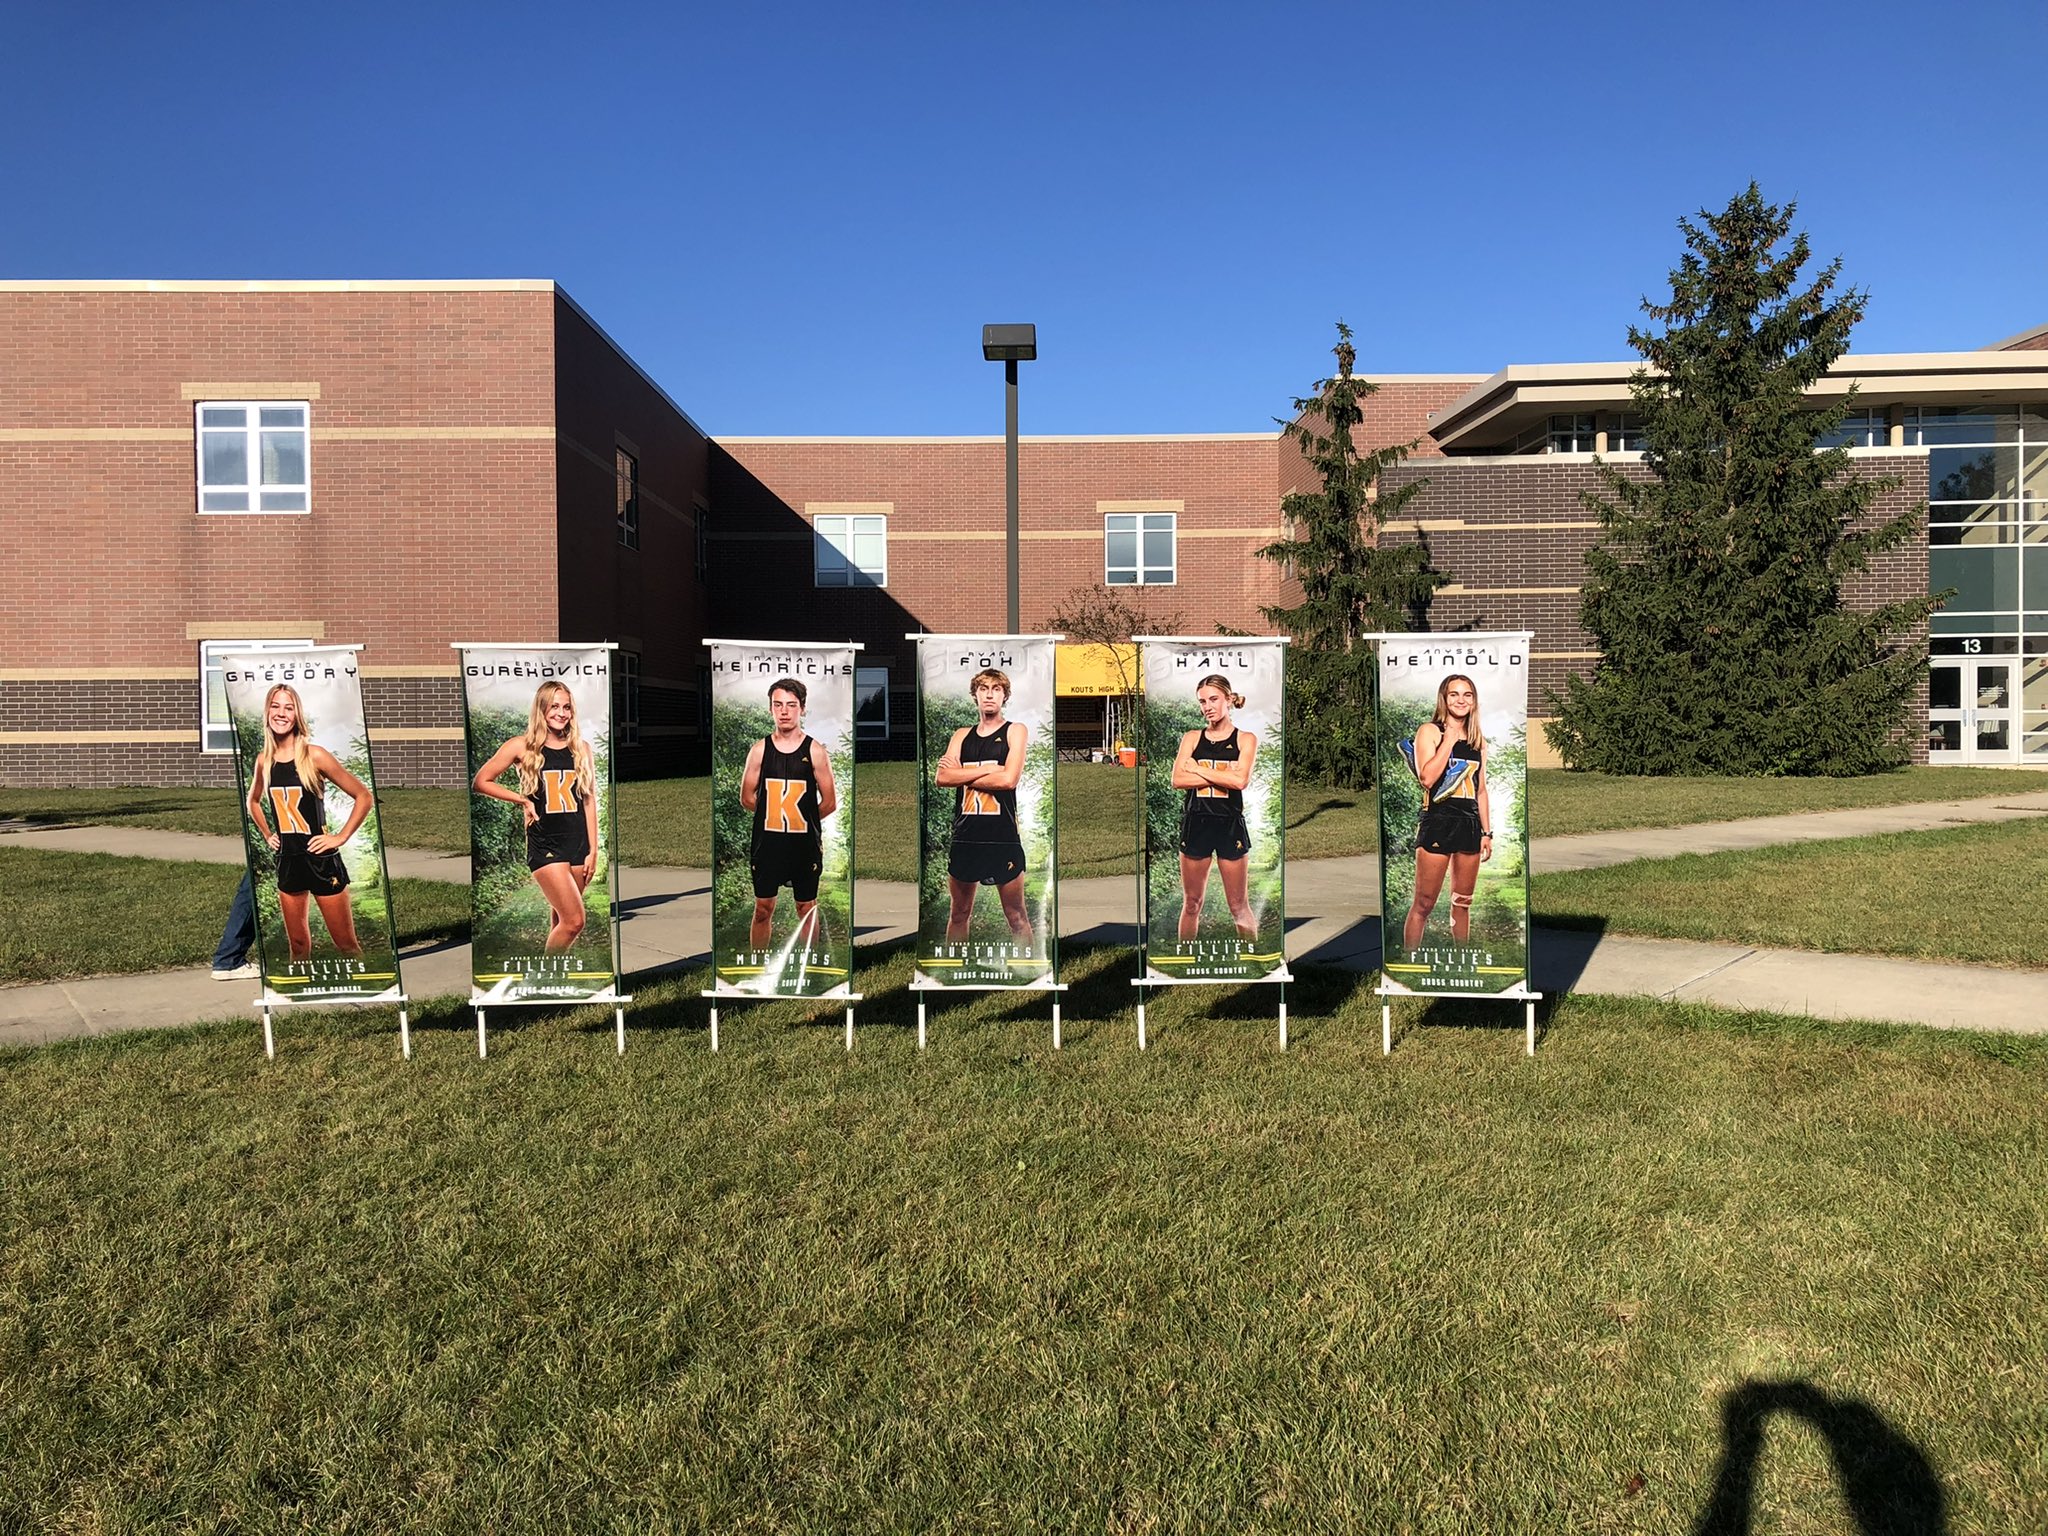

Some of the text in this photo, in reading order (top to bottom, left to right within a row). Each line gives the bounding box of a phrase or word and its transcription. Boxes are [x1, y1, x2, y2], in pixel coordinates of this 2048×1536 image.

[1961, 639, 1982, 654] 13
[754, 655, 814, 663] NATHAN
[1176, 657, 1249, 668] HALL
[1386, 655, 1522, 666] HEINOLD
[712, 661, 853, 675] HEINRICHS
[225, 667, 357, 682] GREGORY
[1071, 686, 1094, 694] KOUTS
[542, 769, 578, 814] K
[269, 786, 312, 836] K
[764, 777, 808, 834] K
[934, 946, 1032, 958] MUSTANGS
[1176, 943, 1255, 955] FILLIES
[736, 953, 830, 966] MUSANGS
[1411, 951, 1493, 965] FILLIES
[288, 962, 366, 976] FILLIES
[503, 960, 583, 972] FILLIES
[980, 971, 1013, 980] COUNTRY
[781, 979, 811, 988] COUNRY
